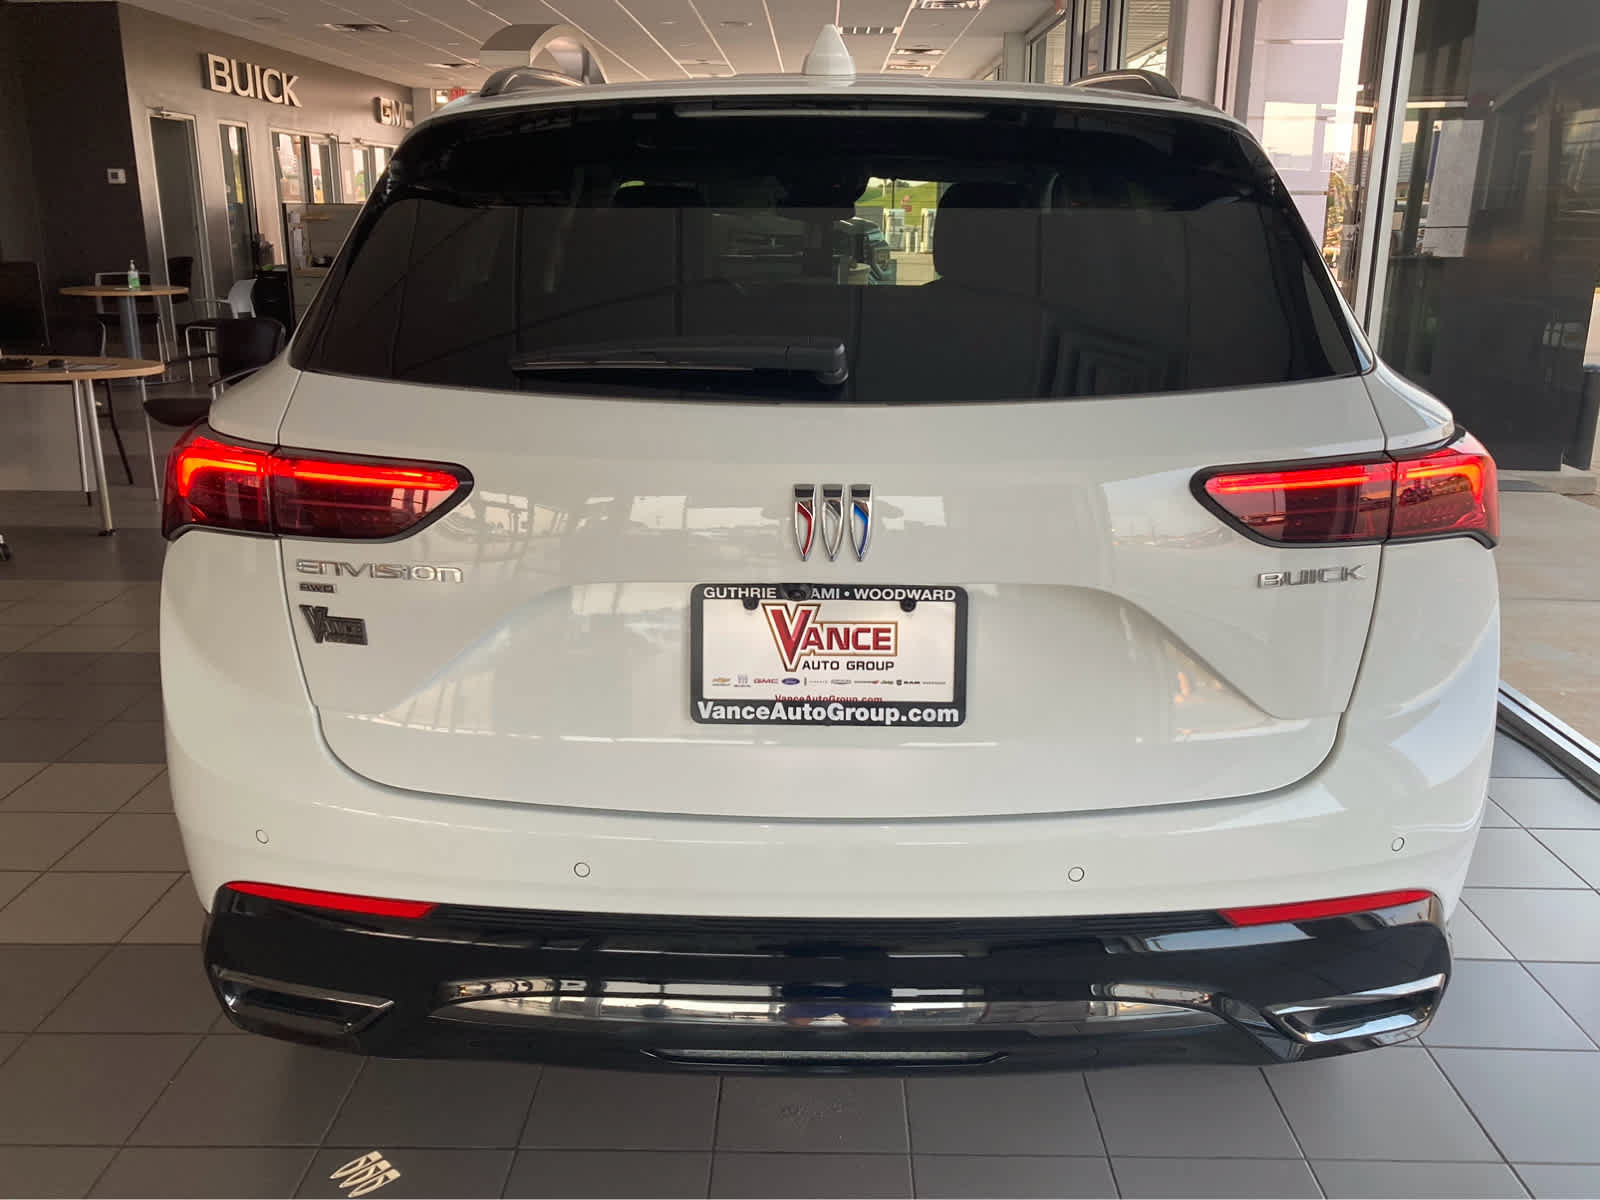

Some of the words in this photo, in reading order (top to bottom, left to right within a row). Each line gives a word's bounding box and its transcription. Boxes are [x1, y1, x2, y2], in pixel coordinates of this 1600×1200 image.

[206, 53, 303, 108] BUICK
[378, 96, 415, 129] GMC
[296, 559, 463, 583] ENVISION
[1257, 563, 1367, 589] BUICK
[703, 587, 777, 599] GUTHRIE
[853, 589, 956, 601] WOODWARD
[768, 606, 894, 668] VANCE
[802, 660, 840, 671] AUTO
[846, 661, 895, 671] GROUP
[697, 701, 959, 725] VanceAutoGroup.com
